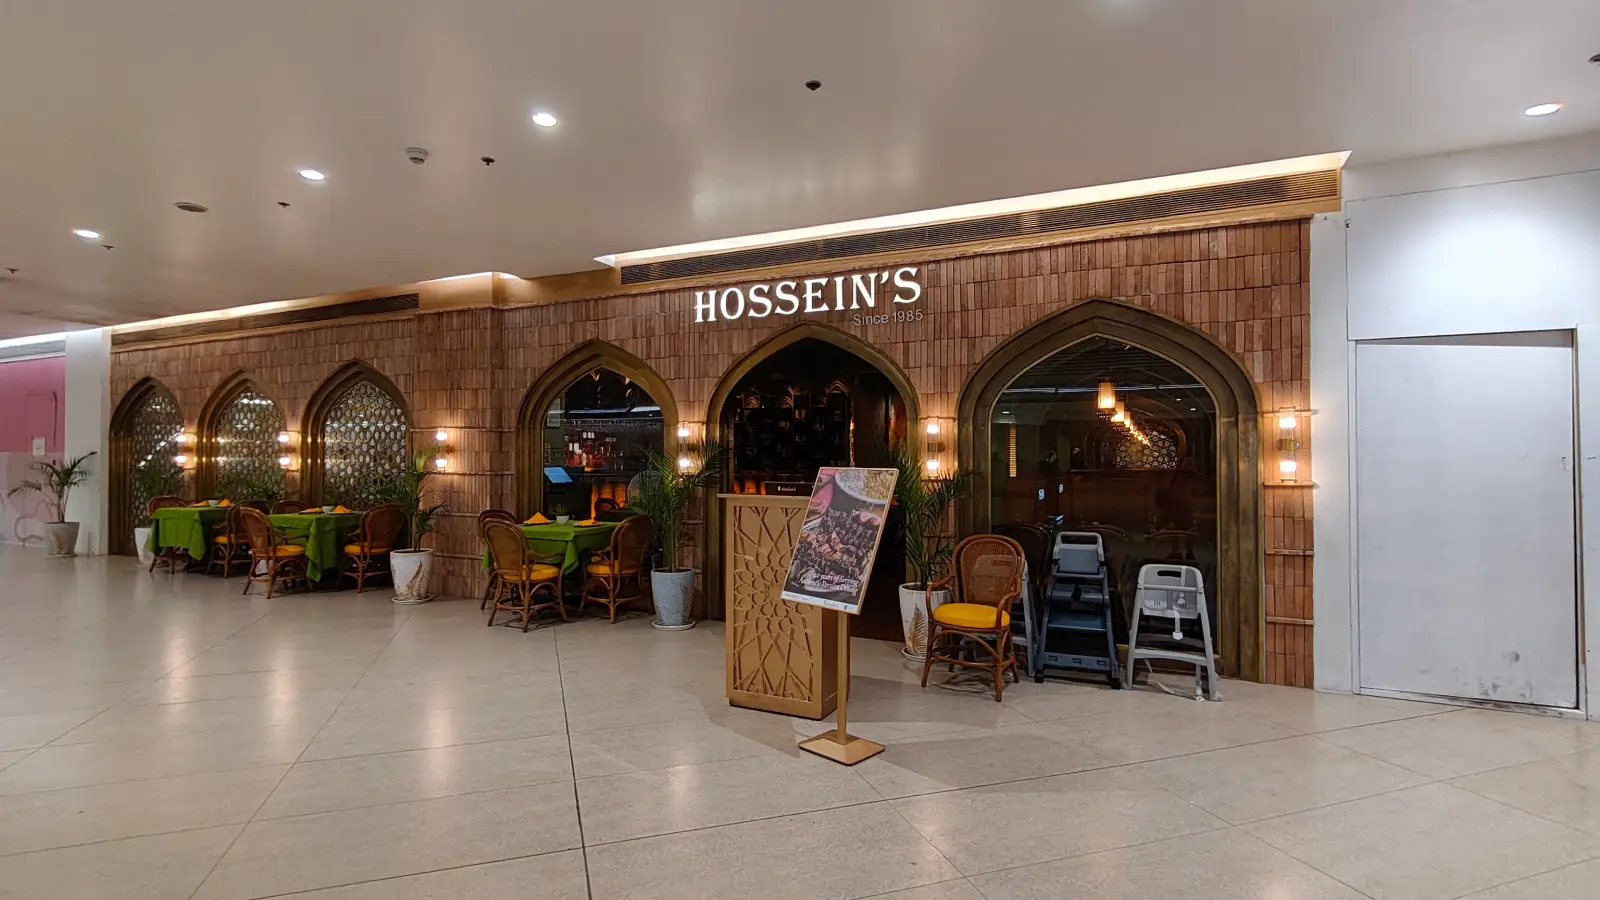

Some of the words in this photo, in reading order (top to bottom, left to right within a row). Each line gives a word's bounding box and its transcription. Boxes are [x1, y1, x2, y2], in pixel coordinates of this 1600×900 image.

[694, 267, 921, 323] HOSSEIN'S
[853, 313, 889, 326] Since
[892, 309, 923, 323] 1985
